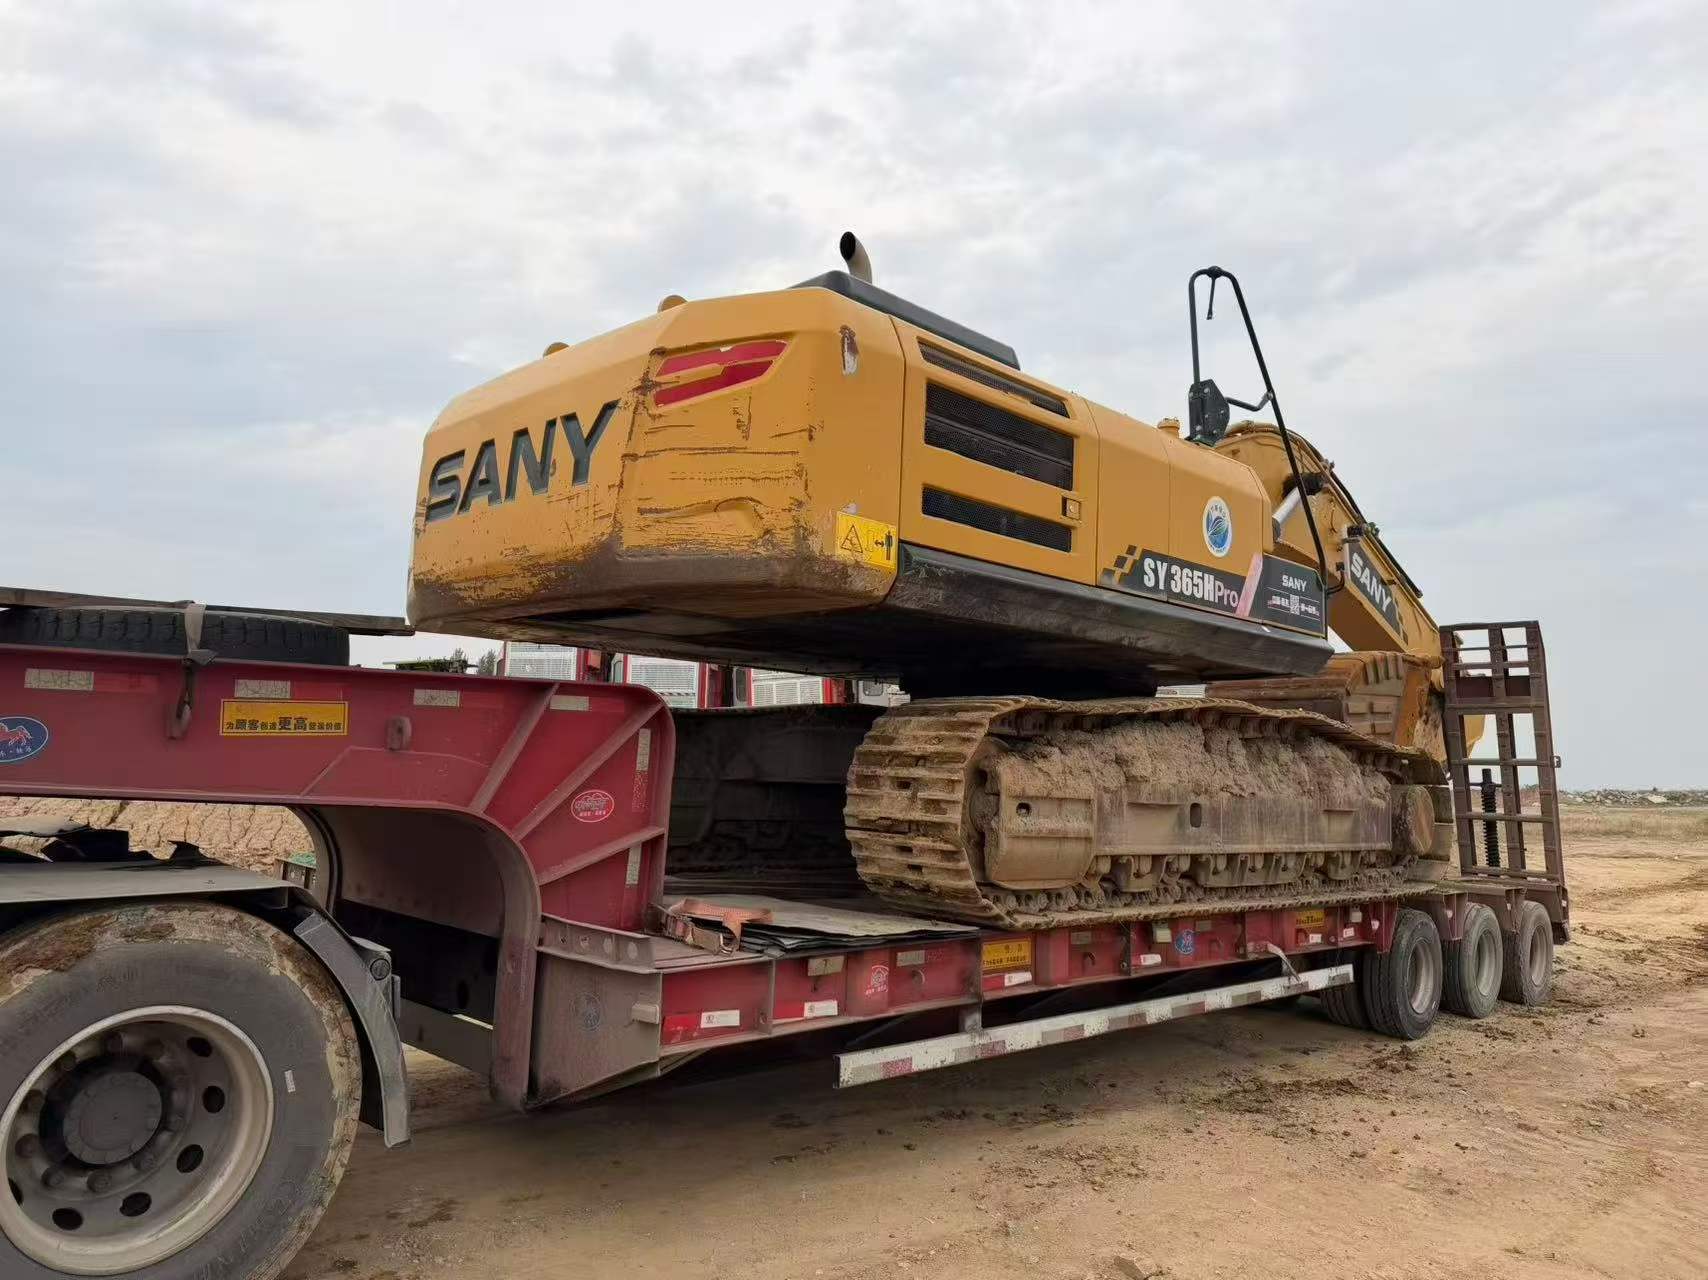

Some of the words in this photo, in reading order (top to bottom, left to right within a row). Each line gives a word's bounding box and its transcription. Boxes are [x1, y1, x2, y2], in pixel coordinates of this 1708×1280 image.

[426, 398, 621, 522] SANY
[1282, 574, 1307, 592] SANY
[1351, 552, 1393, 613] SANY
